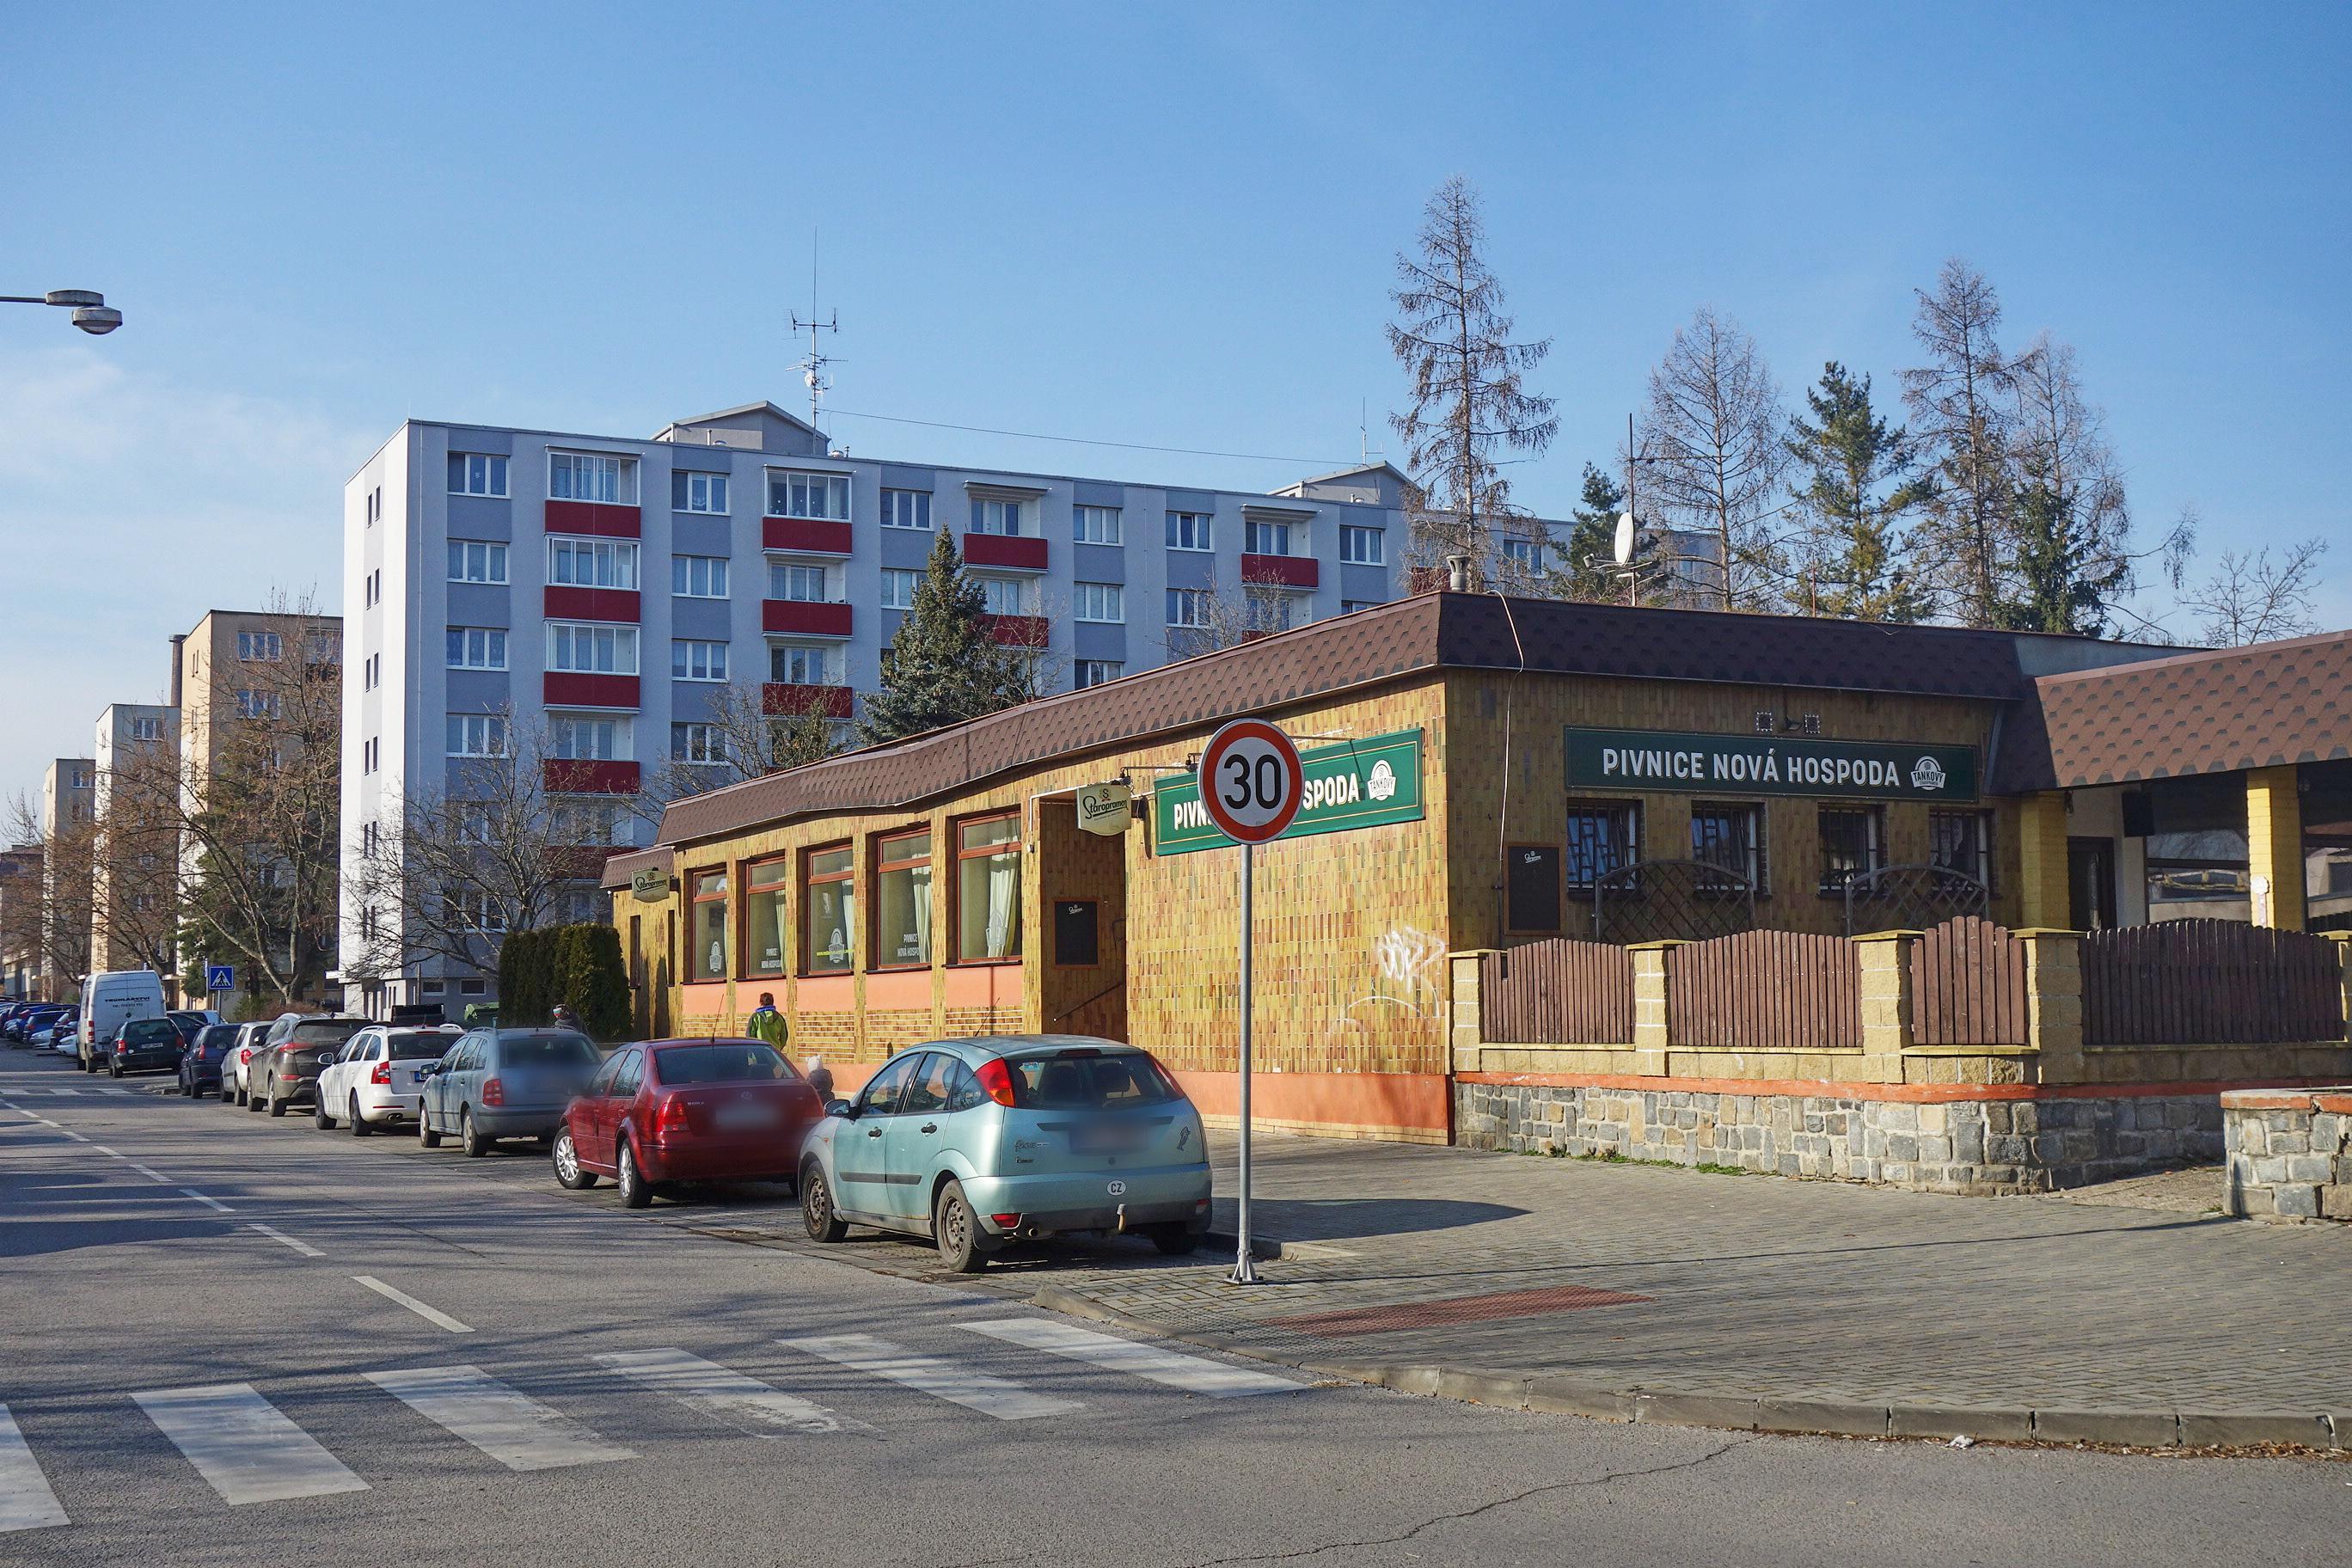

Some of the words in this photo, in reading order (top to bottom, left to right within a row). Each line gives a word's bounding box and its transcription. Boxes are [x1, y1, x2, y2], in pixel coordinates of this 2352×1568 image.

[1224, 754, 1282, 809] 30
[1603, 748, 1705, 780] PIVNICE
[1713, 748, 1780, 782] NOVÁ
[1787, 756, 1901, 787] HOSPODA
[1082, 795, 1128, 819] Staropramen
[1173, 799, 1212, 830] PIVN
[1302, 773, 1360, 811] SPODA
[1111, 1183, 1123, 1193] CZ
